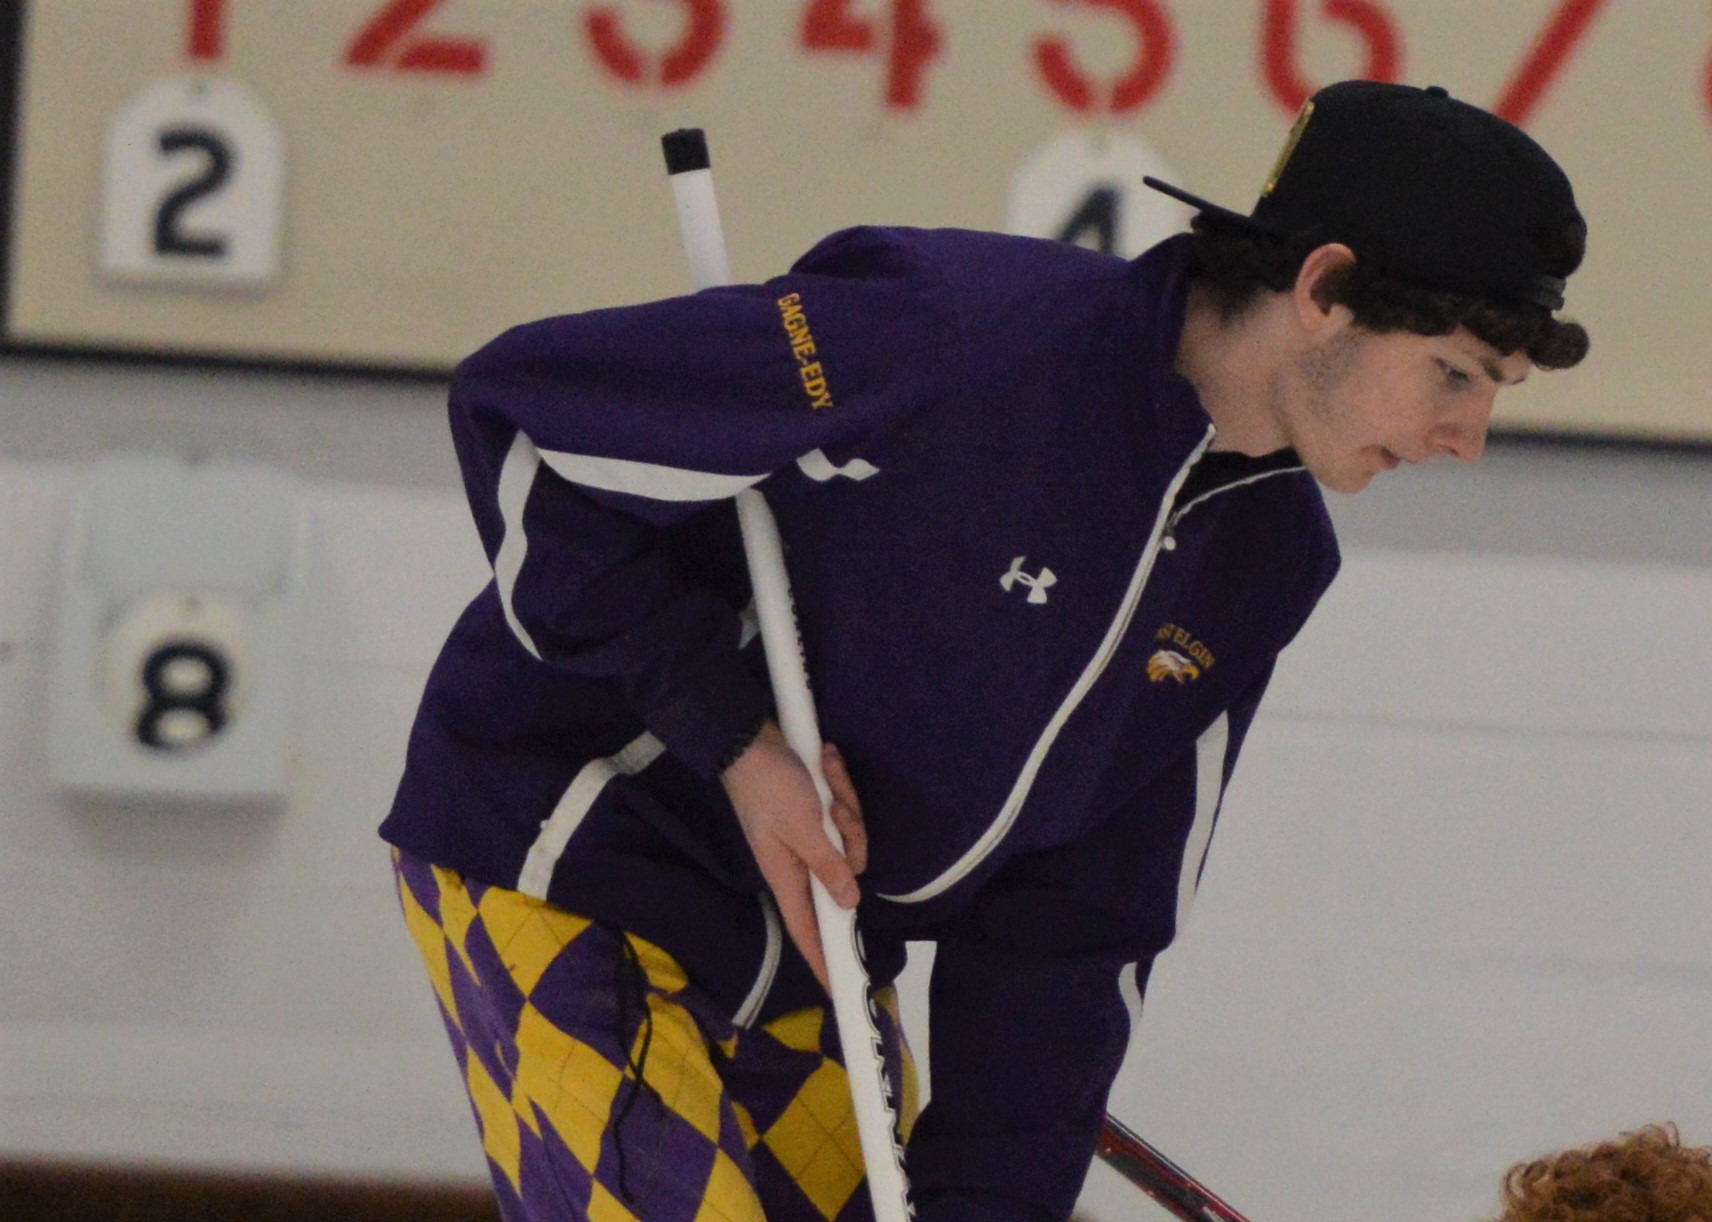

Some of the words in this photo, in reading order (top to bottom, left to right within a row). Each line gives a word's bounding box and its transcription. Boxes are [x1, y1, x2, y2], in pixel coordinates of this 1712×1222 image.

[151, 124, 236, 258] 2
[778, 293, 833, 408] GAGNE-EDY
[134, 638, 234, 754] 8
